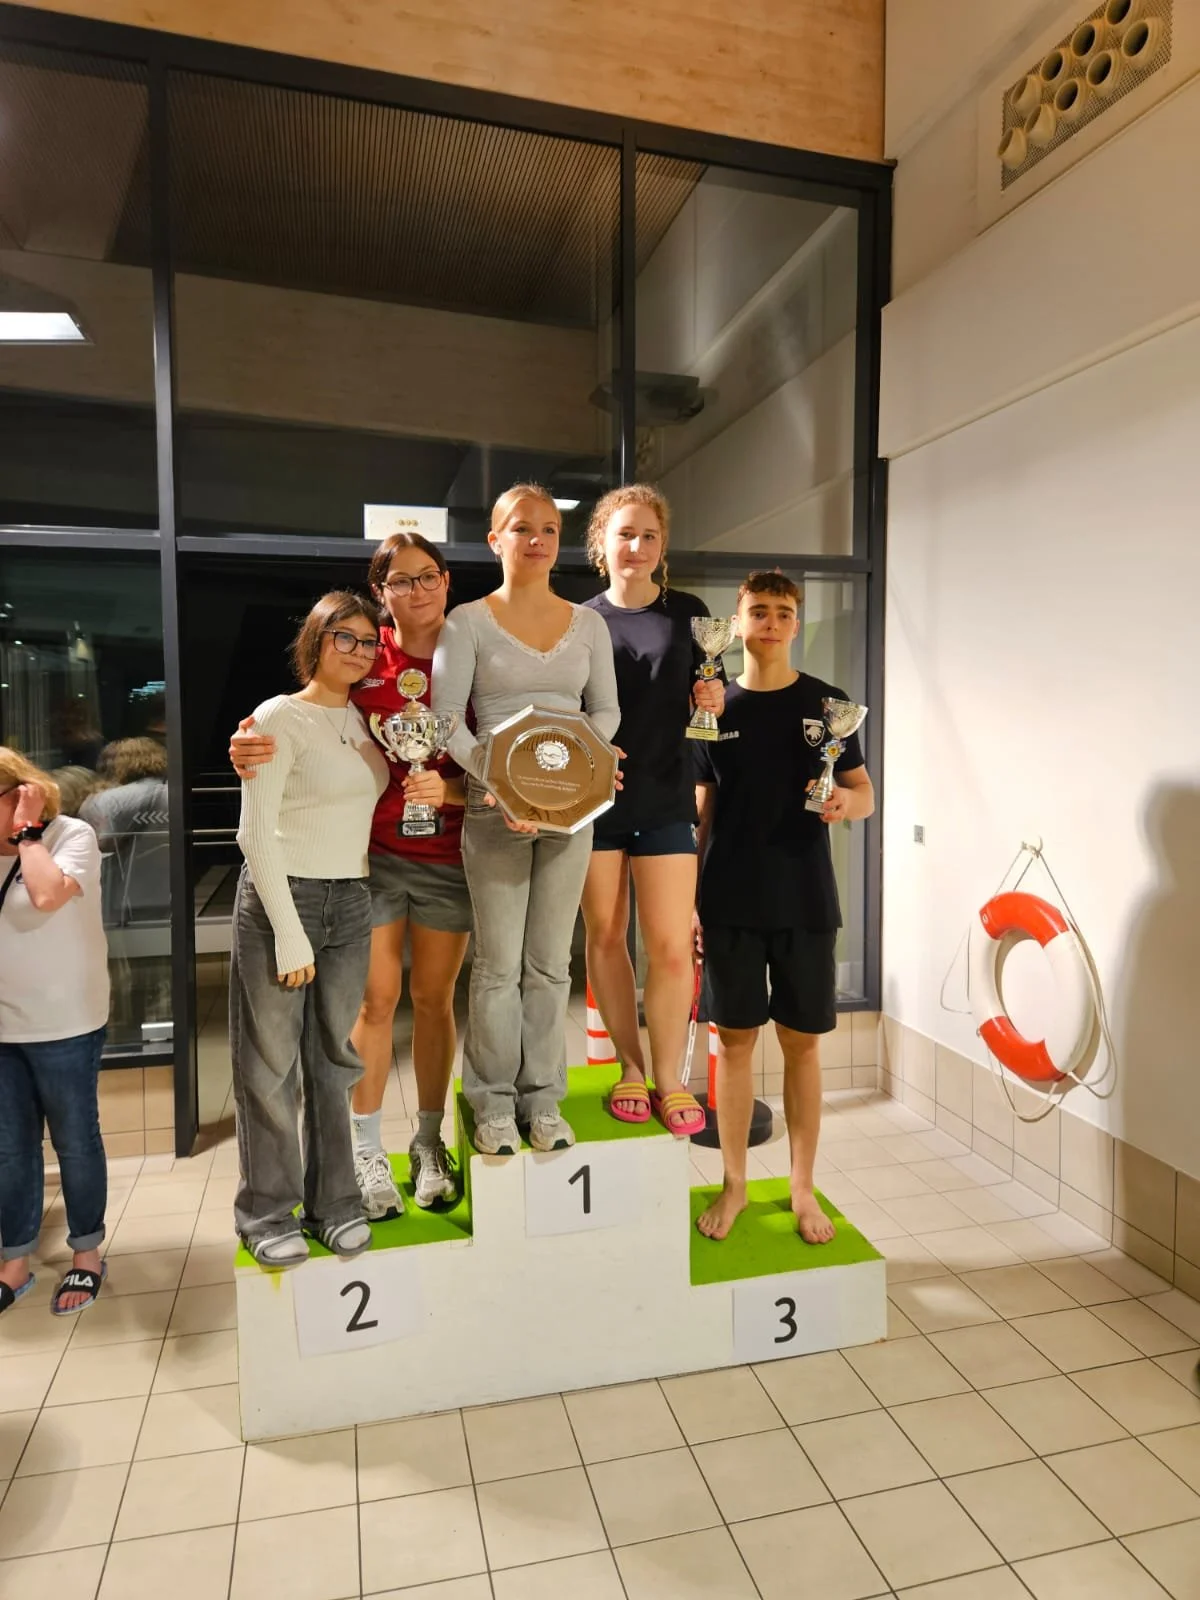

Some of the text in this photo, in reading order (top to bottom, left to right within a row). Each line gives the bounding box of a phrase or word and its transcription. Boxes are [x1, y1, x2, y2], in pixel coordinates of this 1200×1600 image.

[568, 1165, 590, 1214] 1
[340, 1281, 378, 1332] 2
[774, 1297, 797, 1343] 3
